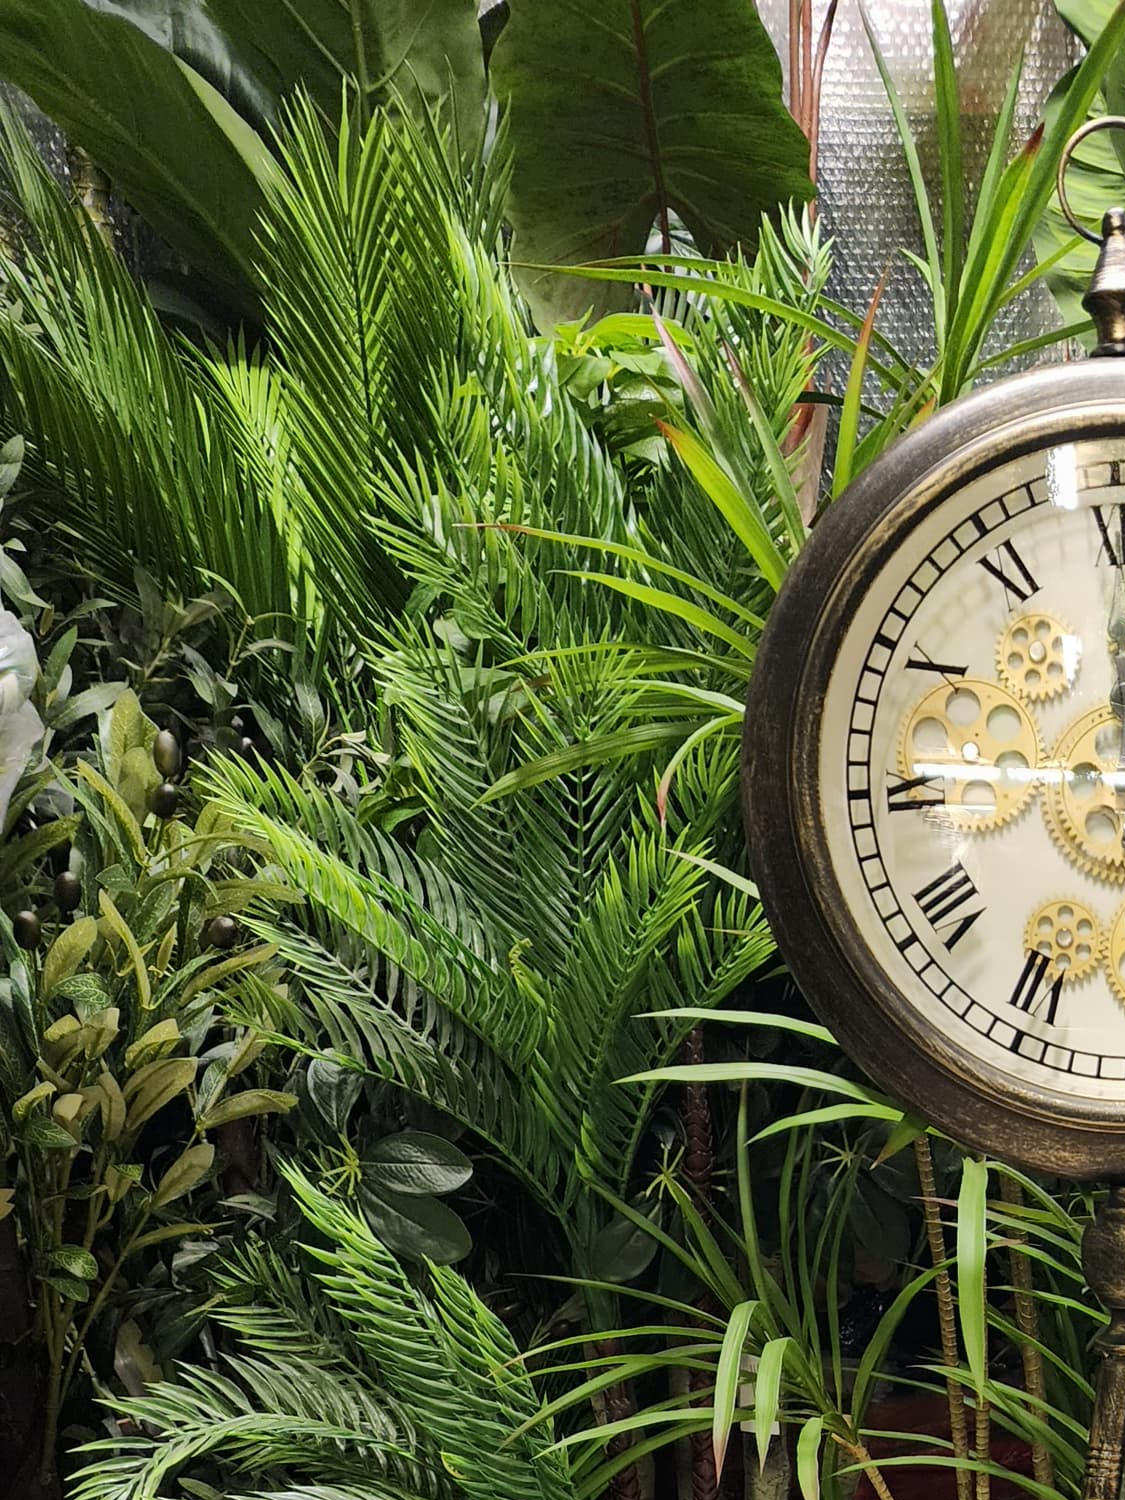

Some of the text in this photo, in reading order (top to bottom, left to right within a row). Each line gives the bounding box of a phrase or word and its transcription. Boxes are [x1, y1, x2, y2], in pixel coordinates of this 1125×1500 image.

[977, 538, 1042, 612] XI
[906, 642, 968, 692] X
[886, 769, 946, 814] IX
[911, 863, 988, 955] VIII
[1008, 949, 1066, 1025] VII
